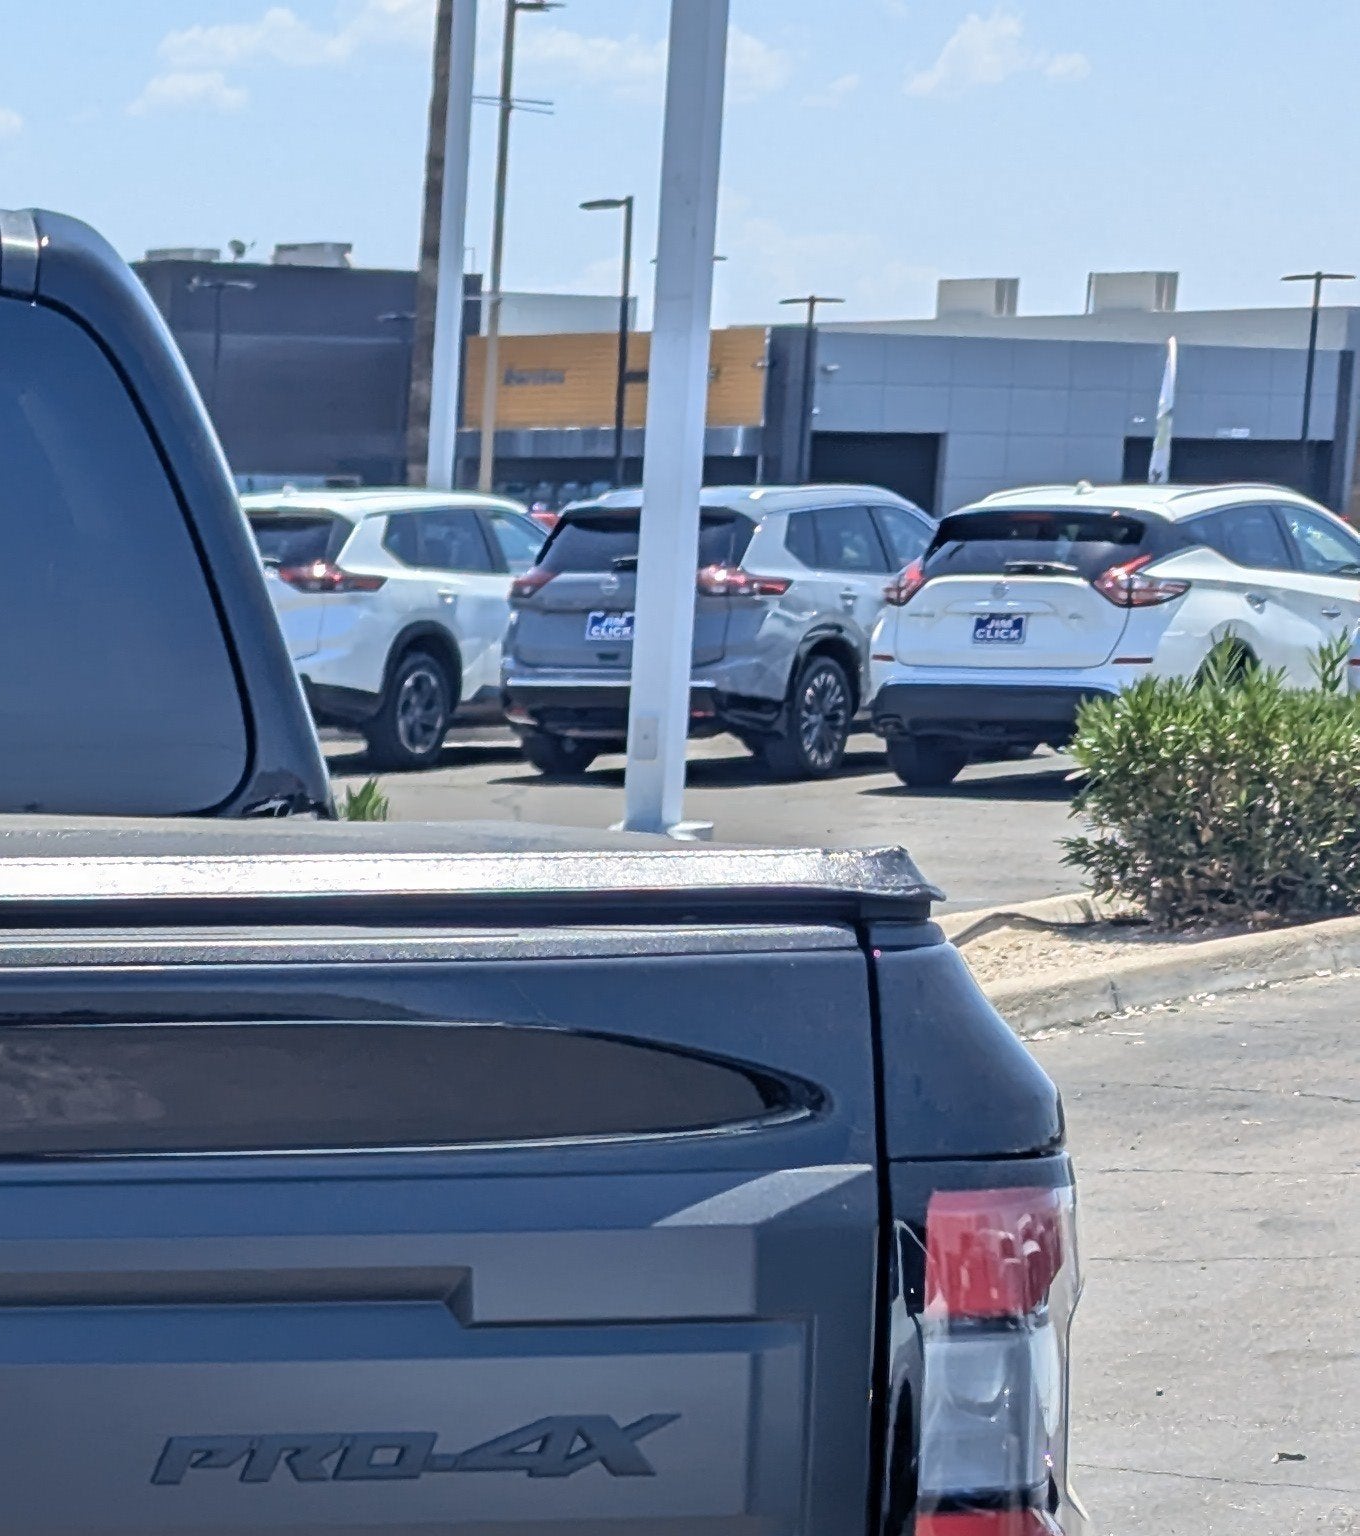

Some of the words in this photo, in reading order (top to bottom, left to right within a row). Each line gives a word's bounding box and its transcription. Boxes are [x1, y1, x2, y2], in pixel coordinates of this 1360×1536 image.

[986, 619, 1013, 629] JIM
[975, 629, 1020, 639] CLICK
[150, 1413, 681, 1485] PRO-4X
